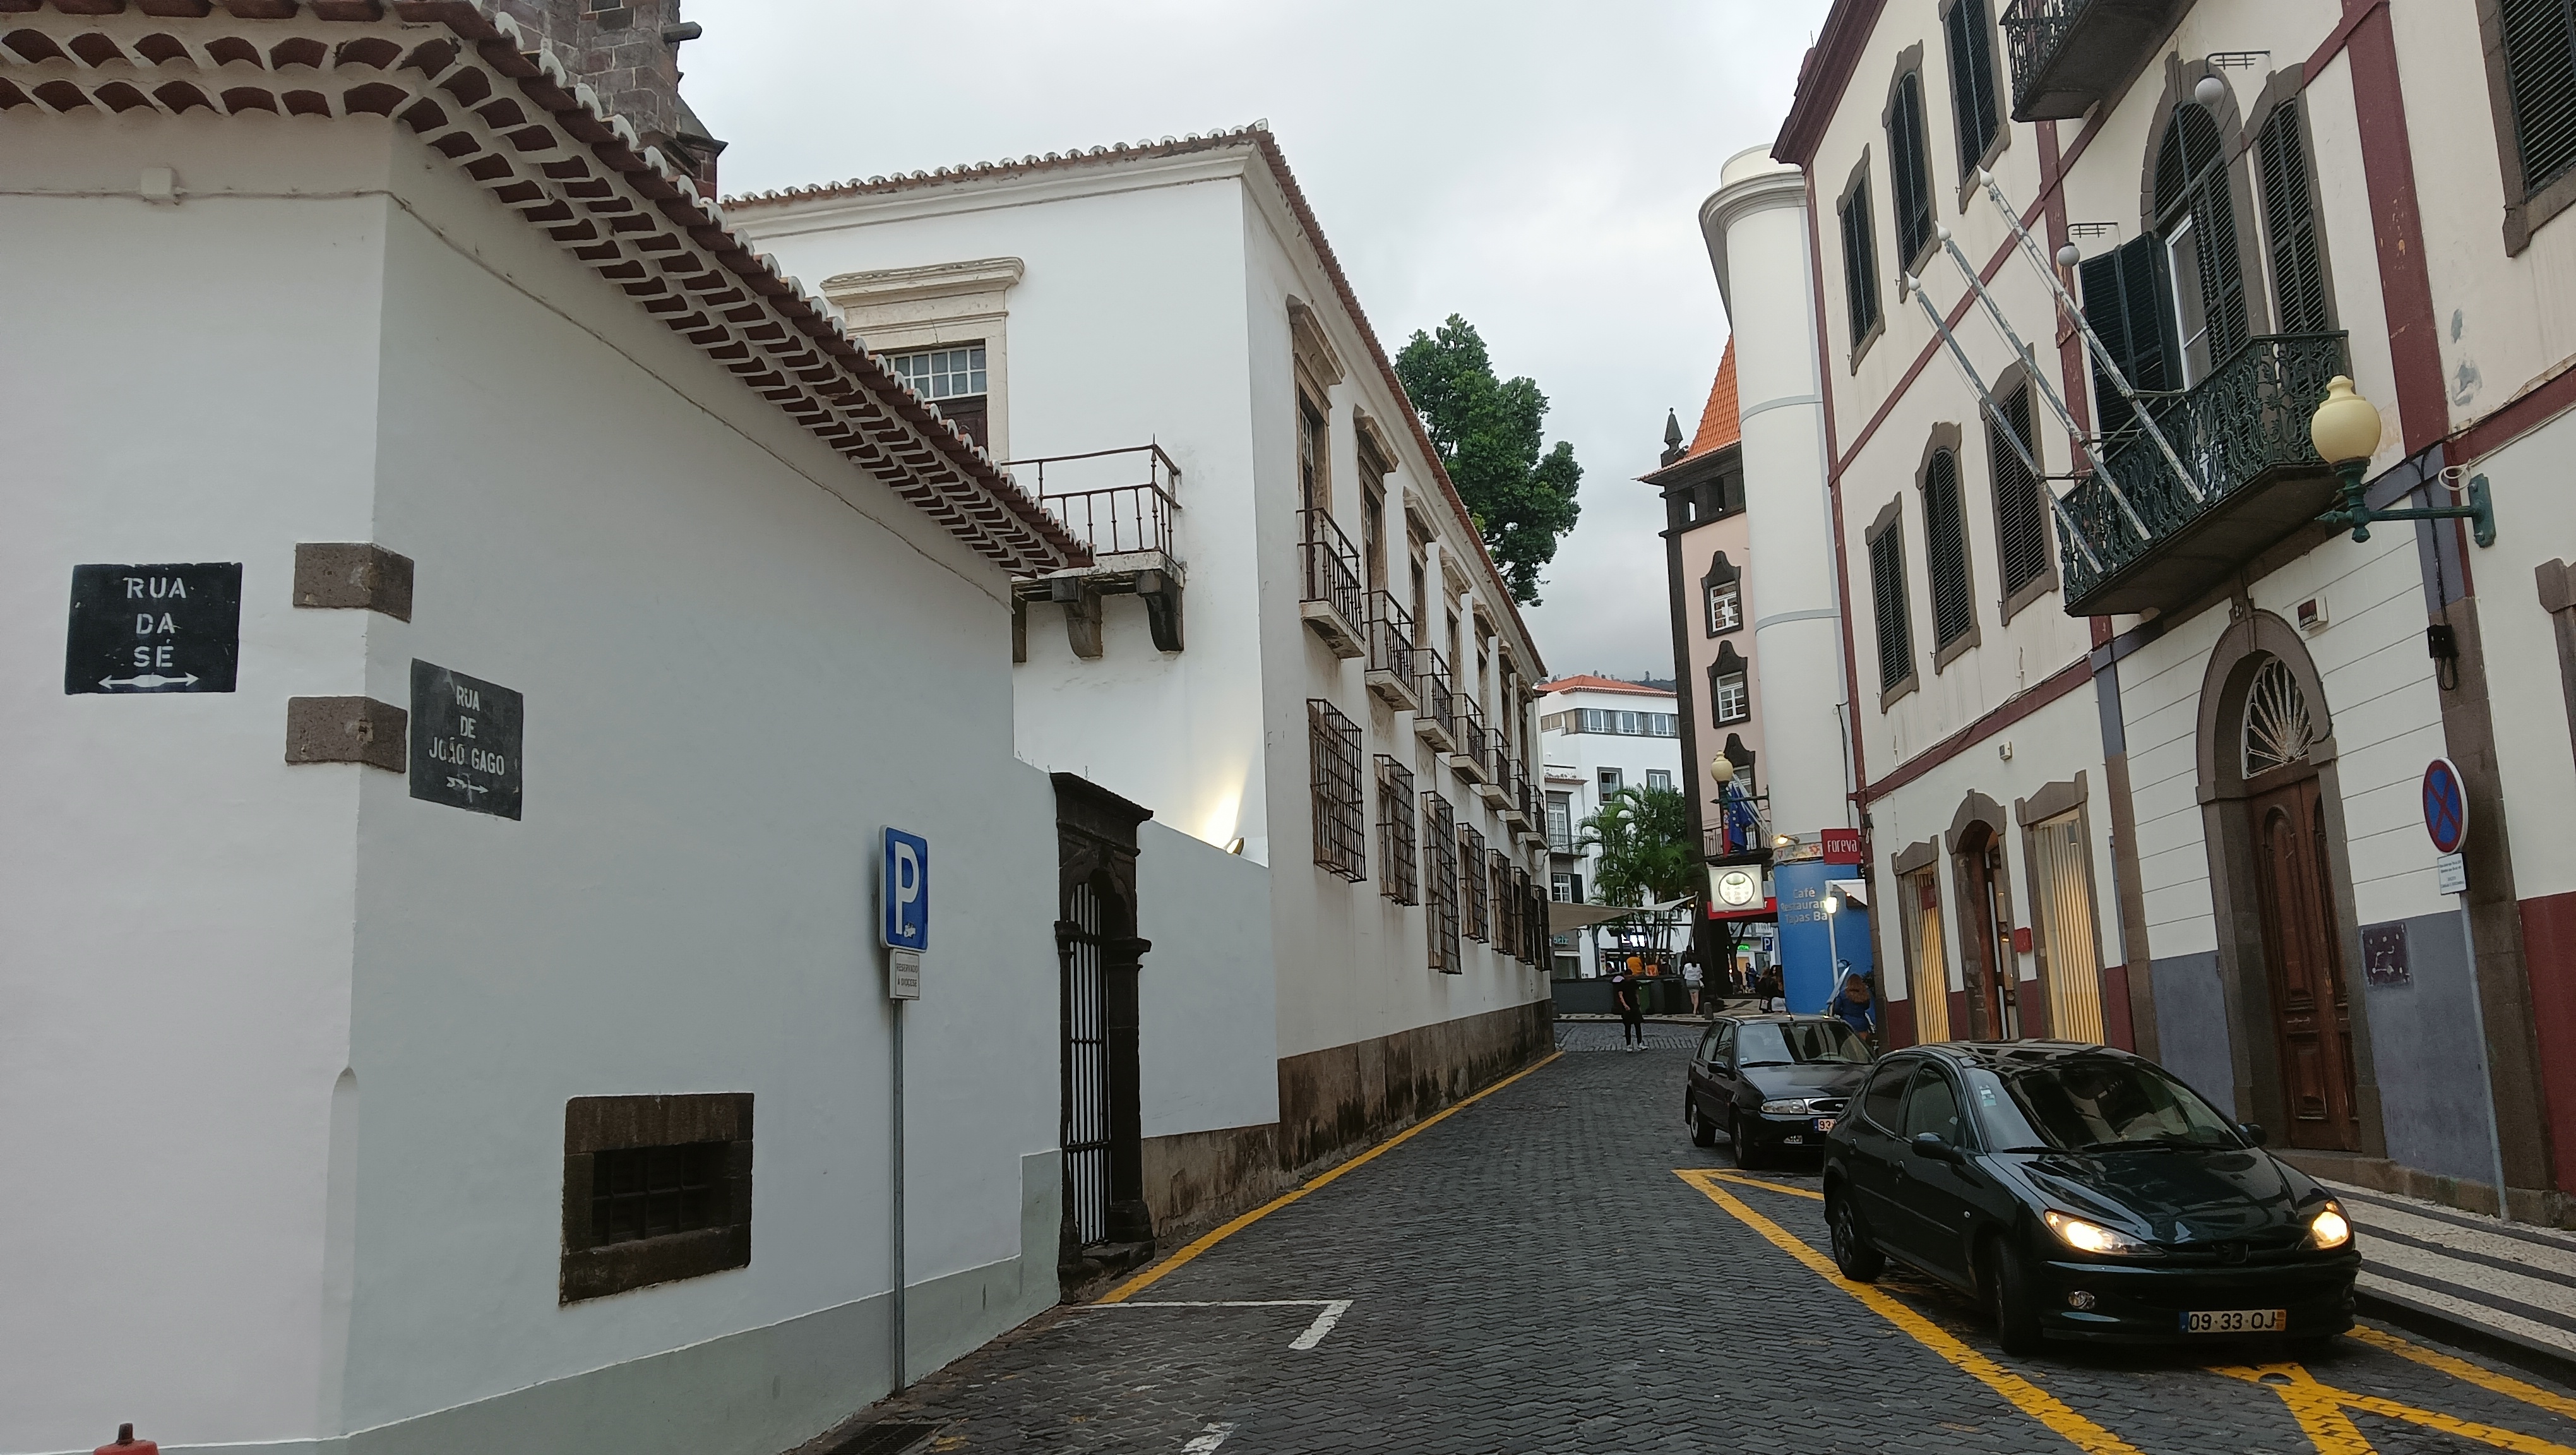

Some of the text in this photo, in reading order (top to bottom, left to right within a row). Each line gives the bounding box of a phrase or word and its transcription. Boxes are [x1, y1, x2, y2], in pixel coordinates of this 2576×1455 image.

[122, 577, 187, 599] RUA
[136, 612, 176, 634] DA
[133, 638, 174, 668] SÉ
[456, 685, 480, 712] RUA
[460, 715, 477, 739] DE
[429, 736, 505, 776] JOÃO GAGO
[894, 841, 920, 935] P
[1794, 886, 1816, 899] Café
[1780, 900, 1827, 913] Restauran
[1784, 911, 1828, 925] Tapas Ba
[1763, 937, 1771, 950] P
